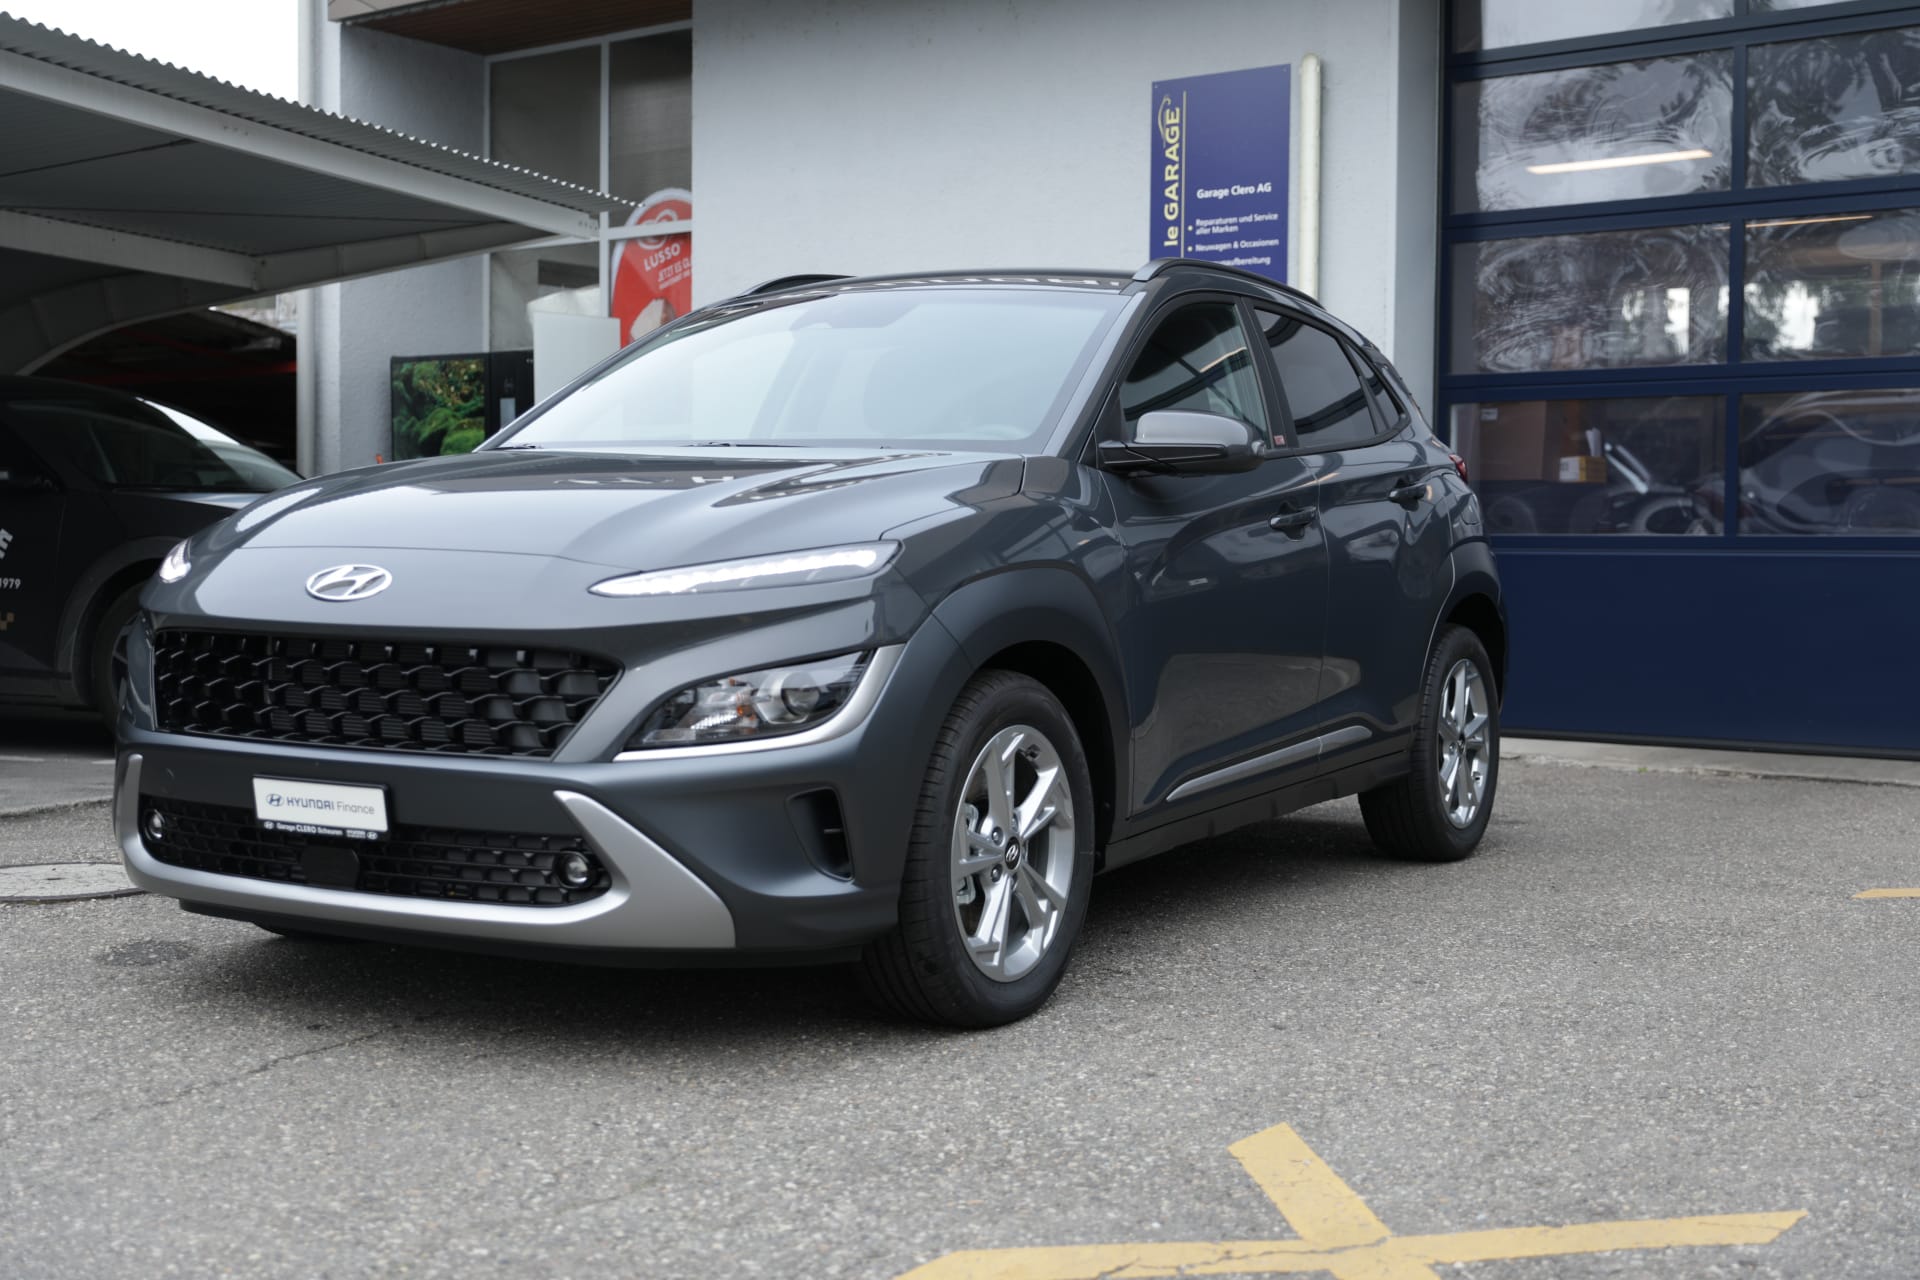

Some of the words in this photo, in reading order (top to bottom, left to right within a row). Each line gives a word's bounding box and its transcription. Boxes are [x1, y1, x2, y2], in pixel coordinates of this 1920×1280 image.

[1164, 107, 1181, 221] GARAGE
[1196, 188, 1230, 199] Garage
[1231, 184, 1255, 196] Clero
[1256, 182, 1272, 193] AG
[1195, 217, 1238, 227] Reparaturen
[1238, 214, 1253, 223] und
[1253, 213, 1278, 222] Service
[1164, 226, 1179, 246] le
[1211, 225, 1239, 234] Marken
[1195, 243, 1232, 252] Neuwagen
[1232, 241, 1239, 249] &
[1239, 239, 1279, 249] Occasionen
[643, 242, 681, 272] LUSSO
[286, 796, 334, 811] HYUNDAI
[336, 801, 375, 815] Finance
